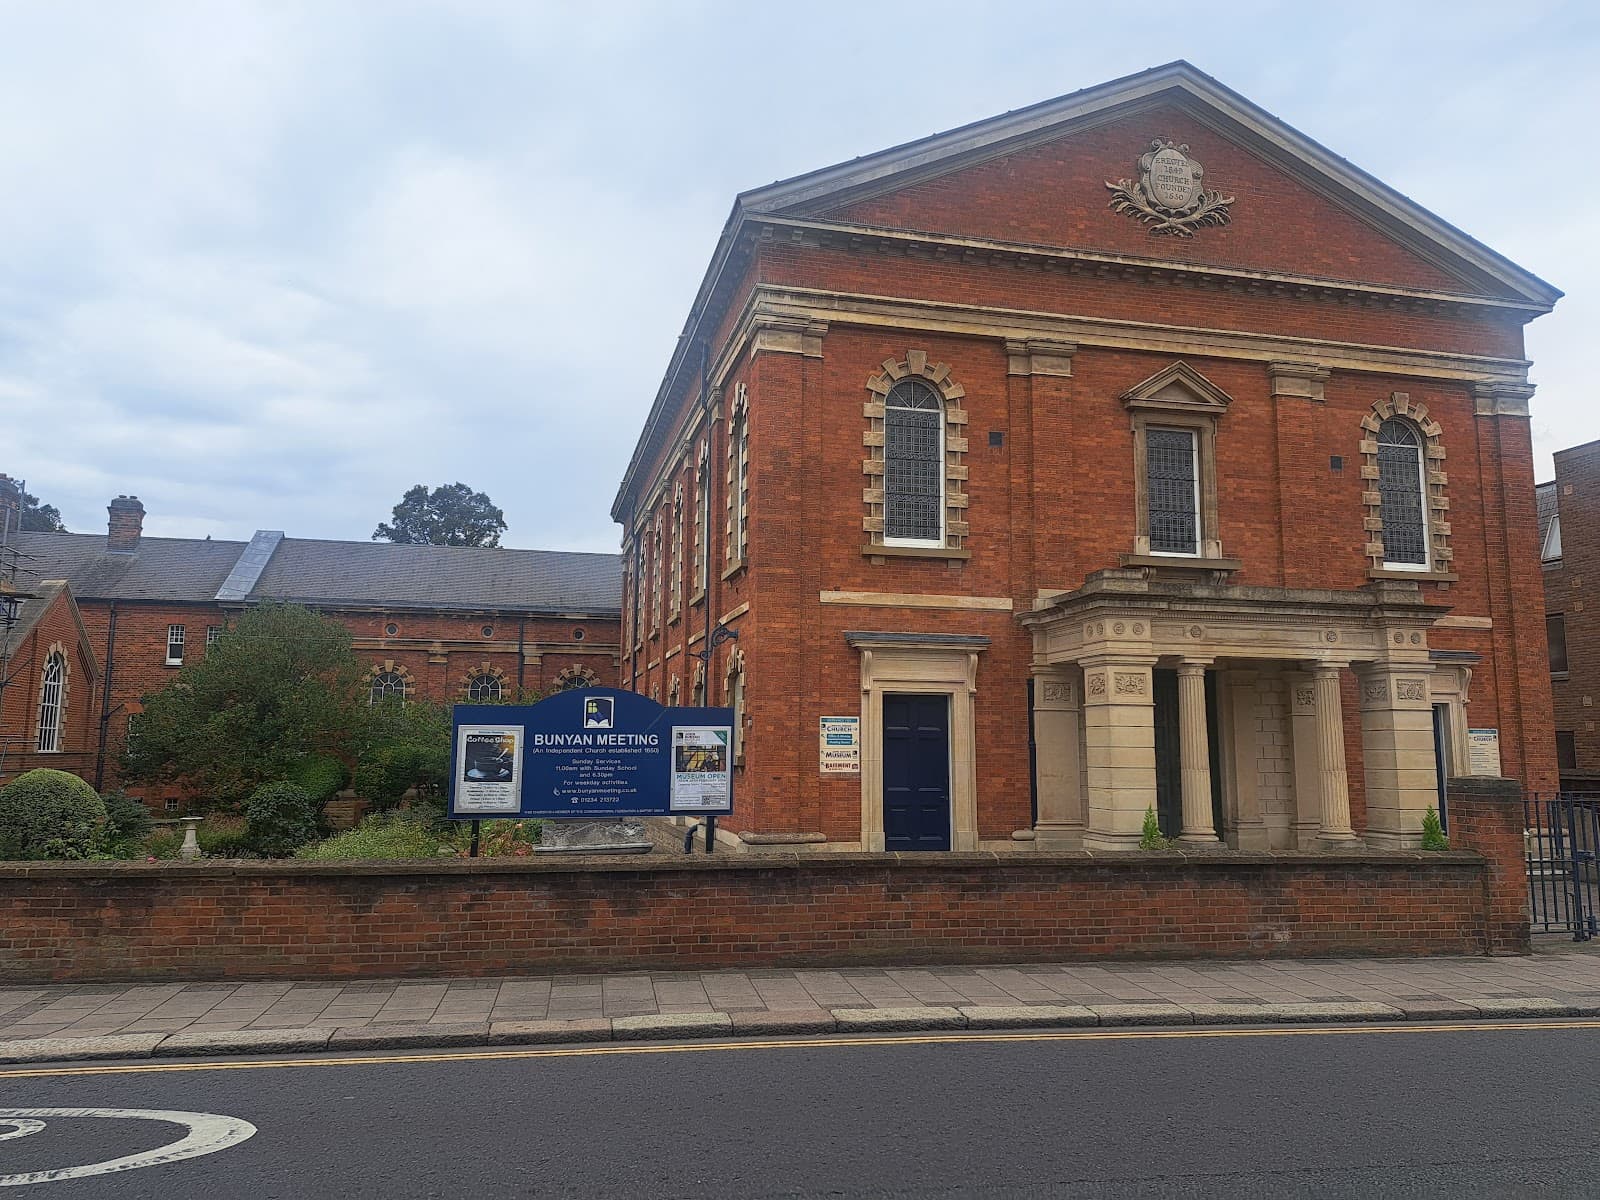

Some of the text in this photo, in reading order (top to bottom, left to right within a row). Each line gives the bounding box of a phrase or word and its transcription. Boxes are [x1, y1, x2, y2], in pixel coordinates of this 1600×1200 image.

[1157, 174, 1190, 185] CHURCH
[495, 735, 514, 744] Shop
[534, 734, 658, 746] BUNYAN MEETING
